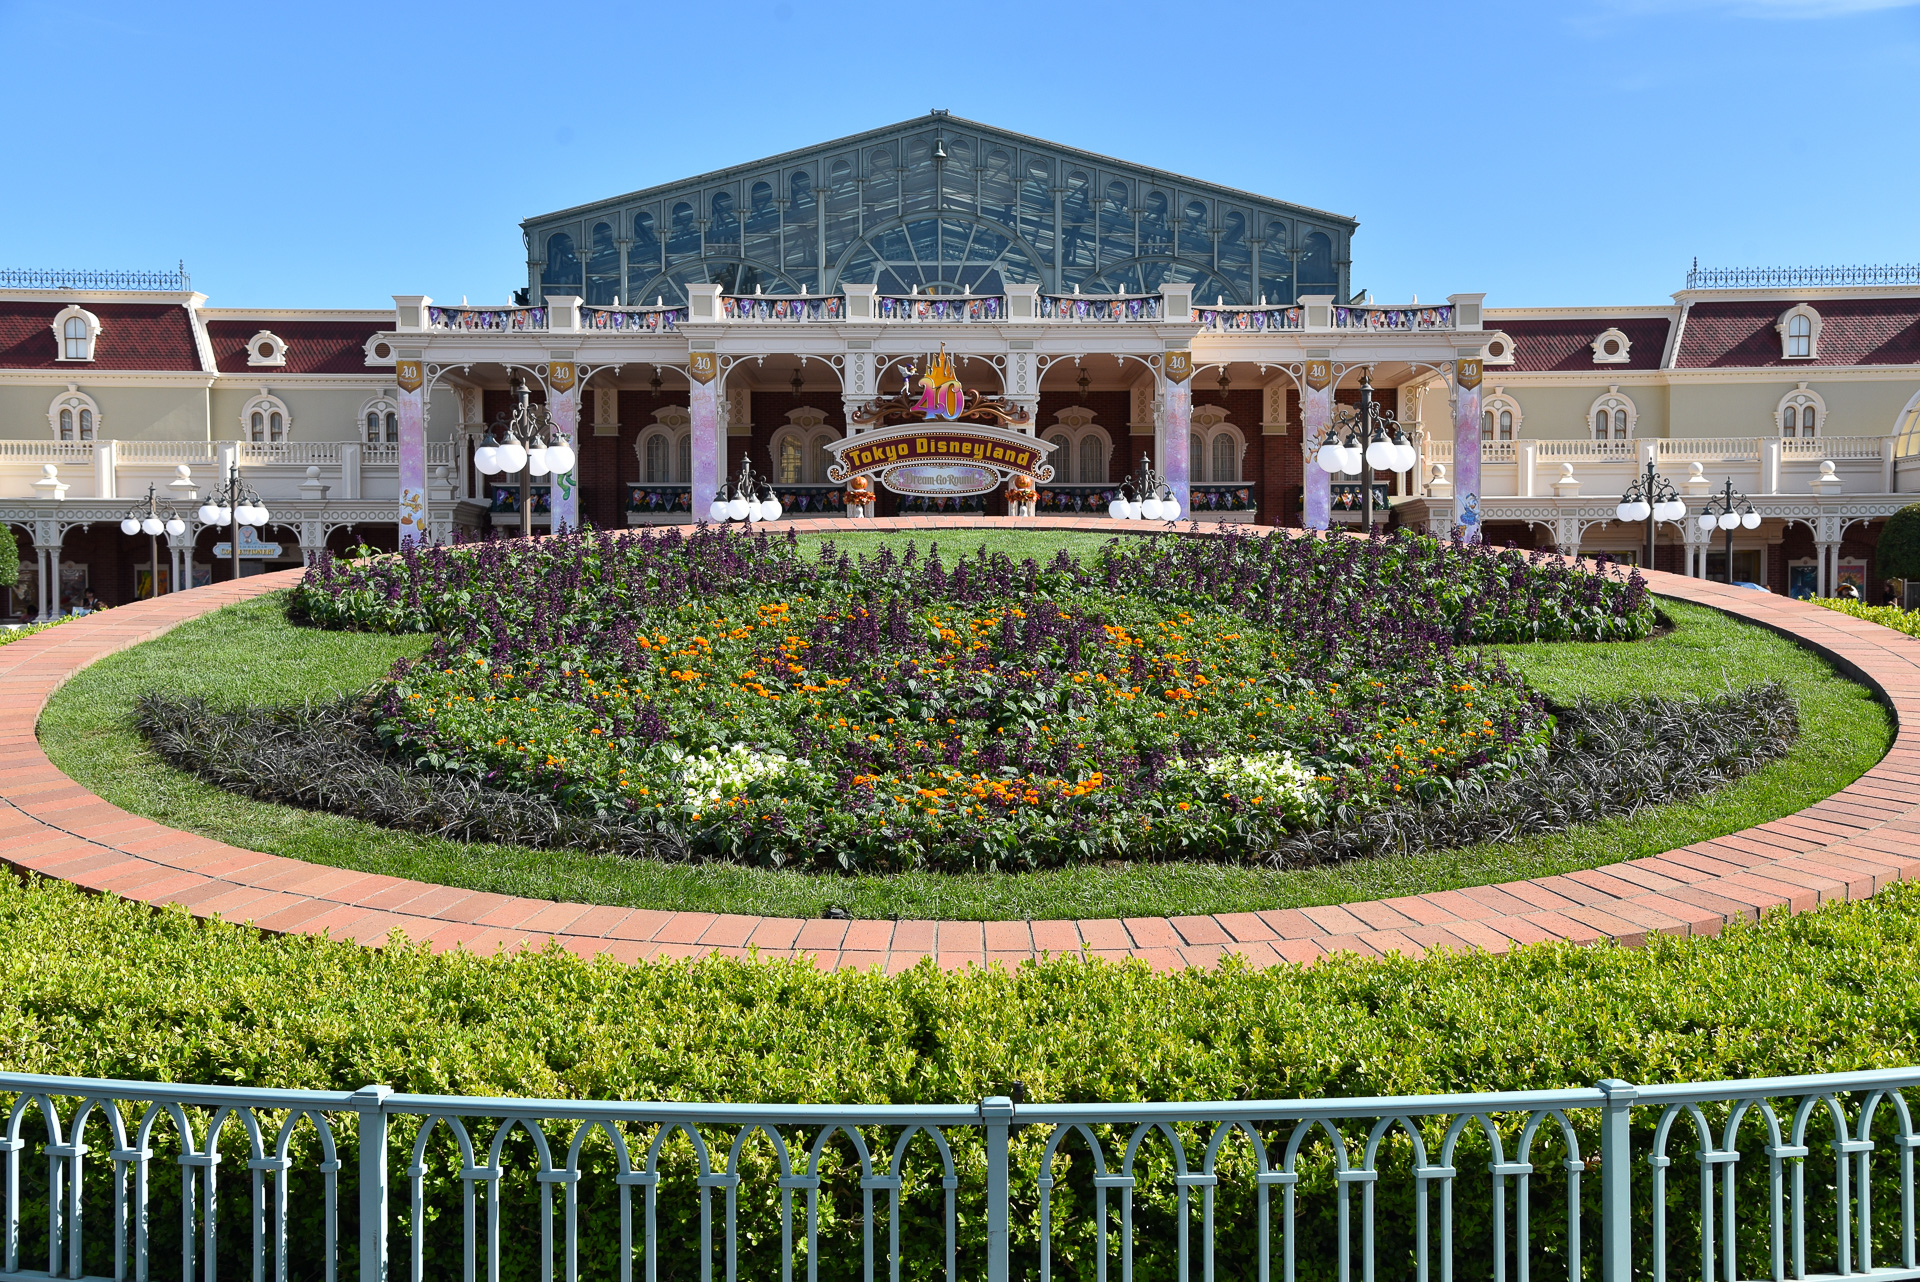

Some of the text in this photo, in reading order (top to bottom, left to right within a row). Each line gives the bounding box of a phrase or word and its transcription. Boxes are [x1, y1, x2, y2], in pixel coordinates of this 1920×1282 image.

[694, 356, 711, 370] 40
[1169, 356, 1185, 369] 40
[401, 365, 417, 378] 40
[553, 366, 569, 379] 40
[1310, 364, 1326, 377] 40
[1461, 363, 1477, 376] 40
[910, 377, 965, 421] 40
[849, 438, 1030, 467] Tokyo Disneyland
